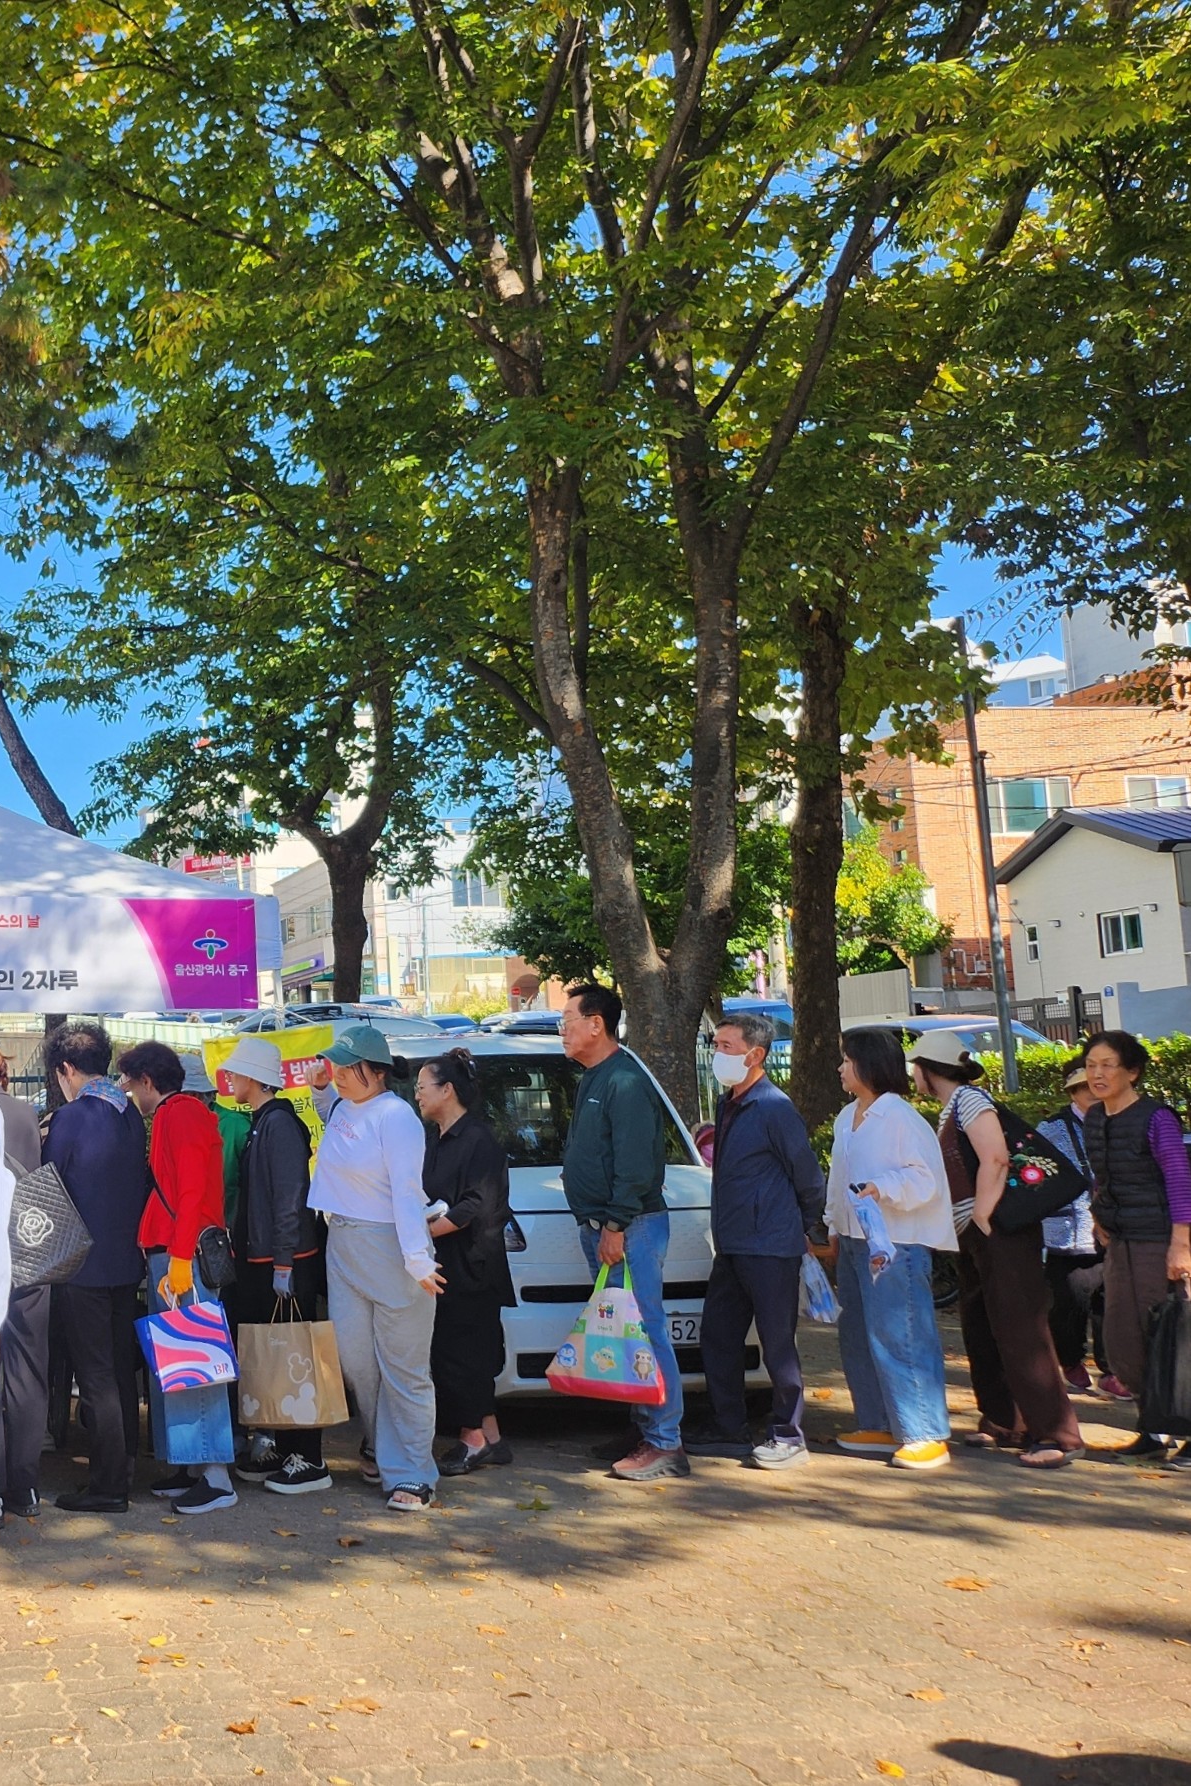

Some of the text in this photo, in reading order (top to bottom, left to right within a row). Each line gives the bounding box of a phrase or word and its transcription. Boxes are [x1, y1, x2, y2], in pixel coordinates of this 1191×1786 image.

[27, 914, 40, 929] 날
[174, 963, 249, 976] 울산광역시 중구
[22, 970, 79, 991] 2자루
[667, 1320, 697, 1340] 52
